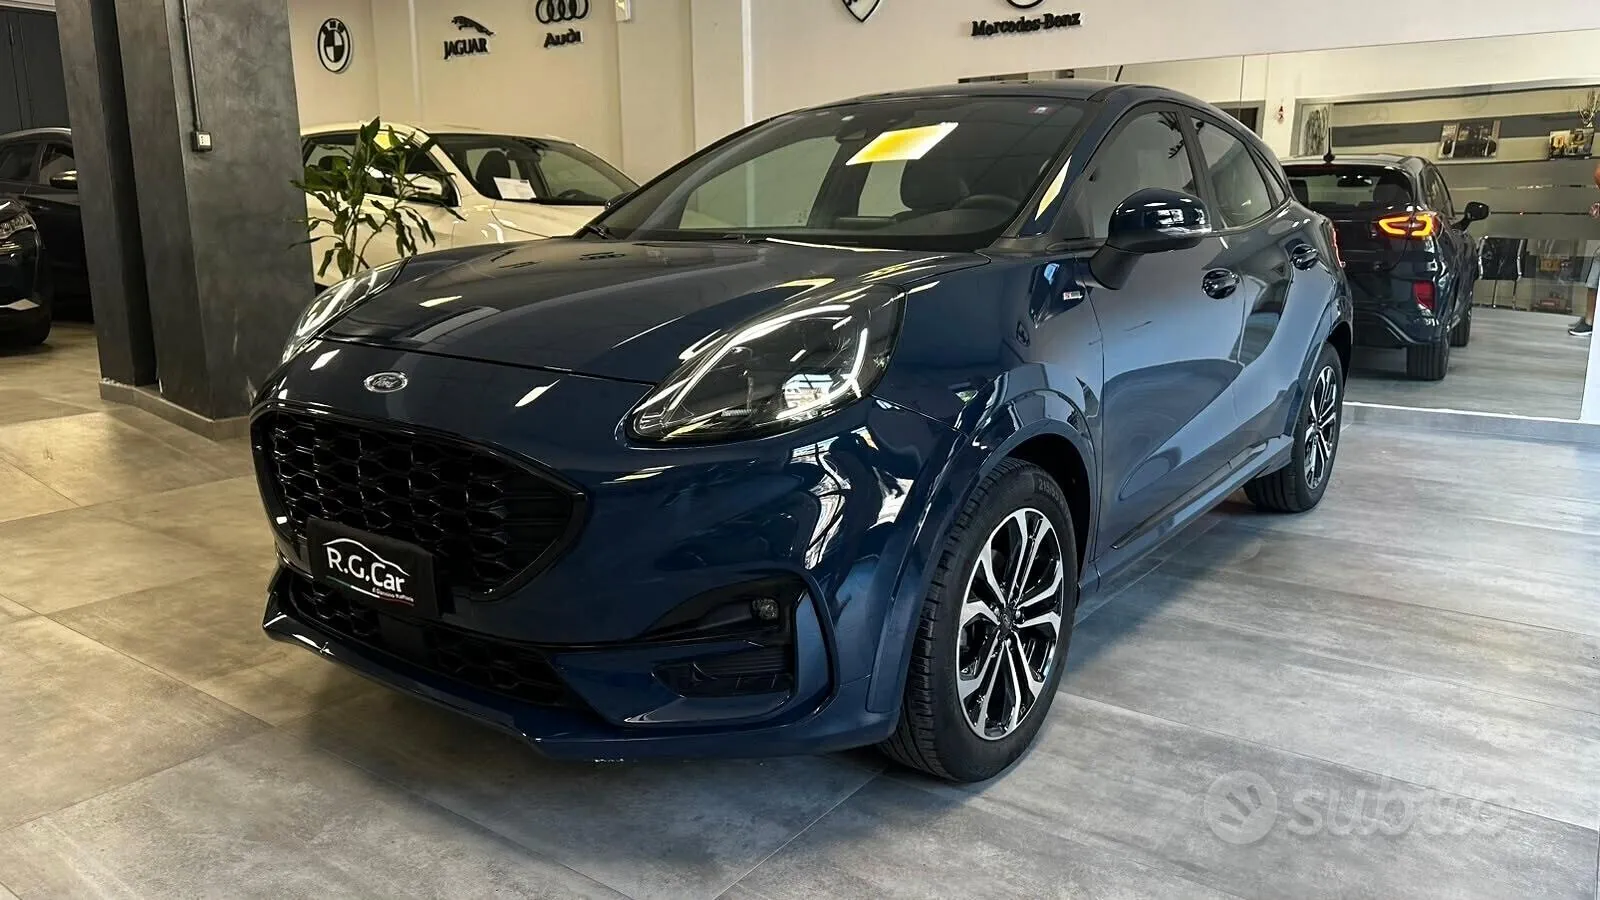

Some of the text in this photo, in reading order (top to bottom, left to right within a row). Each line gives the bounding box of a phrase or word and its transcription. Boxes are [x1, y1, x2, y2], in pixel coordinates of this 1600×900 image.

[971, 12, 1081, 37] Mercedes-Benz
[443, 38, 488, 60] JAGUAR
[543, 28, 583, 48] Audi
[326, 546, 405, 593] R.G.Car
